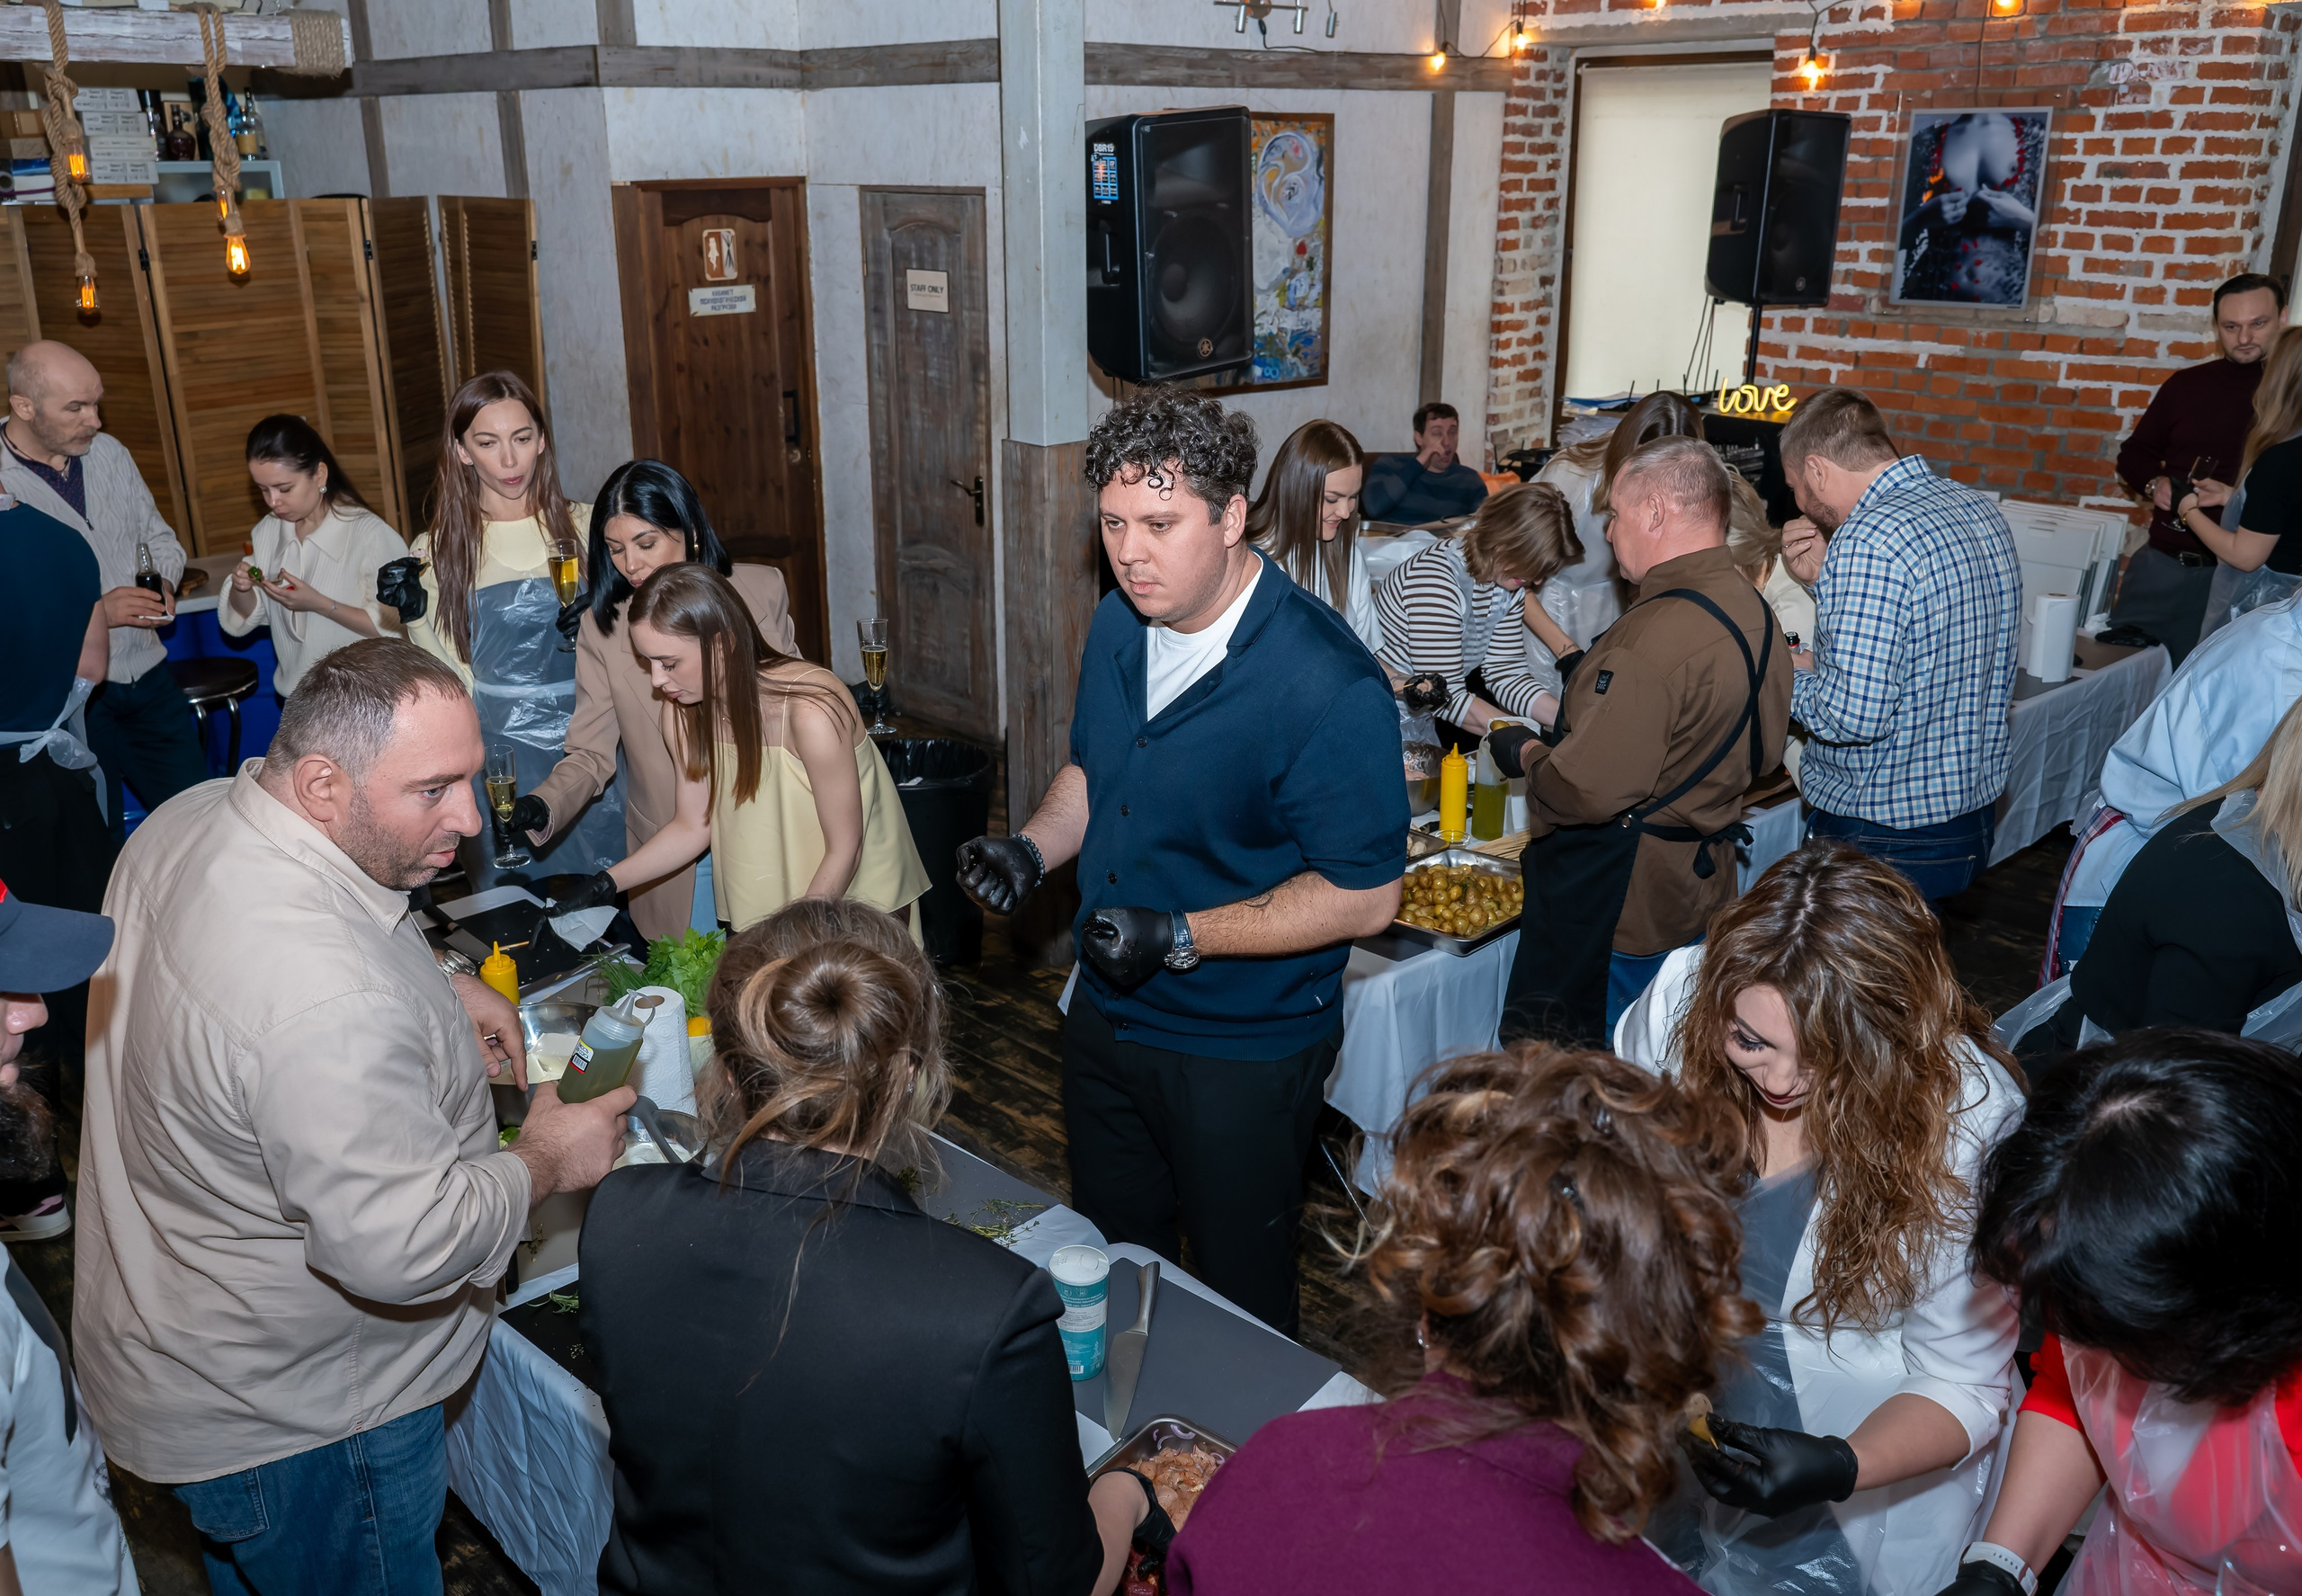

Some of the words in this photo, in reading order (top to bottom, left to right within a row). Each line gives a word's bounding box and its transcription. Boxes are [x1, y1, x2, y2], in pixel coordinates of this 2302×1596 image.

[910, 283, 926, 292] STAFF
[927, 285, 944, 294] ONLY
[1718, 377, 1798, 414] love
